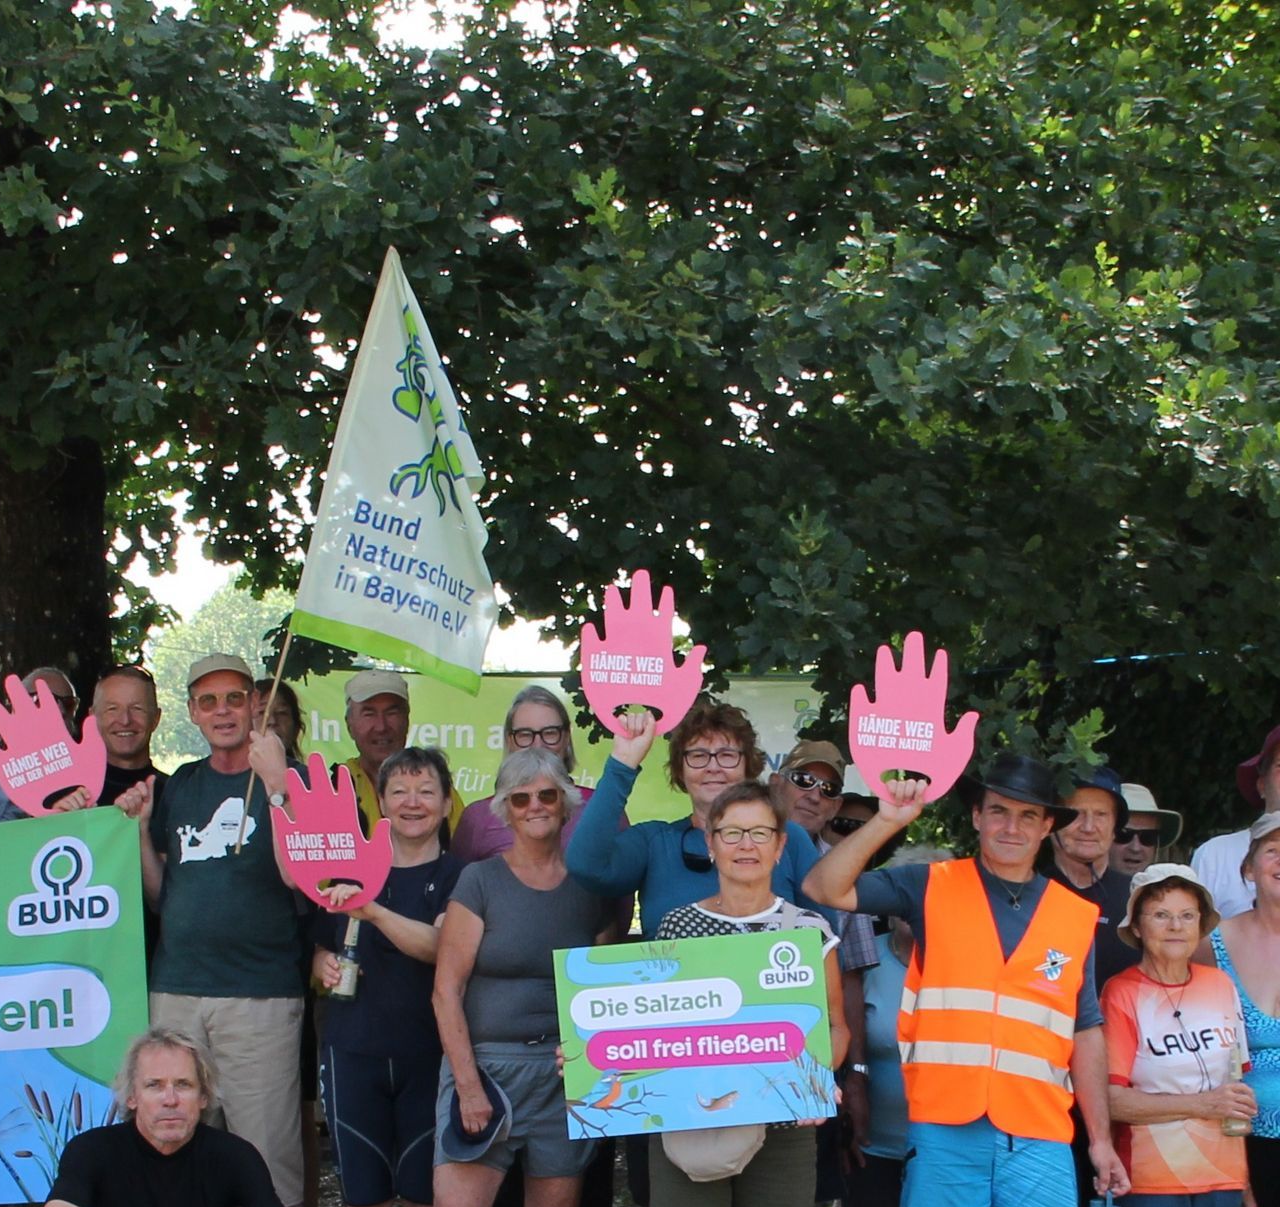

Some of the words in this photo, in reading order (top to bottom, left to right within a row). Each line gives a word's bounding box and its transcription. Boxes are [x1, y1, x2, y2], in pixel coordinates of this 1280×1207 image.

[353, 499, 422, 542] Bund
[344, 532, 475, 606] Naturschutz
[334, 564, 358, 593] in
[363, 575, 439, 622] Bayern
[590, 651, 633, 672] HÄNDE
[635, 656, 664, 673] WEG
[590, 670, 609, 683] VON
[609, 671, 628, 684] DER
[630, 673, 663, 686] NATUR!
[311, 710, 340, 743] In
[858, 713, 902, 736] HÄNDE
[905, 720, 934, 739] WEG
[857, 733, 876, 746] VON
[877, 736, 897, 749] DER
[898, 738, 932, 752] NATUR!
[2, 757, 42, 778] HÄNDE
[41, 741, 69, 762] WEG
[7, 775, 27, 789] VON
[26, 768, 44, 782] DER
[43, 756, 73, 775] NATUR!
[454, 766, 492, 793] für
[285, 831, 326, 849] HÄNDE
[326, 833, 355, 849] WEG
[288, 850, 306, 861] VON
[307, 849, 325, 861] DER
[326, 848, 356, 860] NATUR!
[18, 895, 109, 926] BUND
[764, 969, 809, 986] BUND
[590, 997, 628, 1018] Die
[634, 989, 723, 1015] Salzach
[605, 1039, 648, 1061] soll
[652, 1036, 693, 1058] frei
[697, 1032, 786, 1055] fließen!
